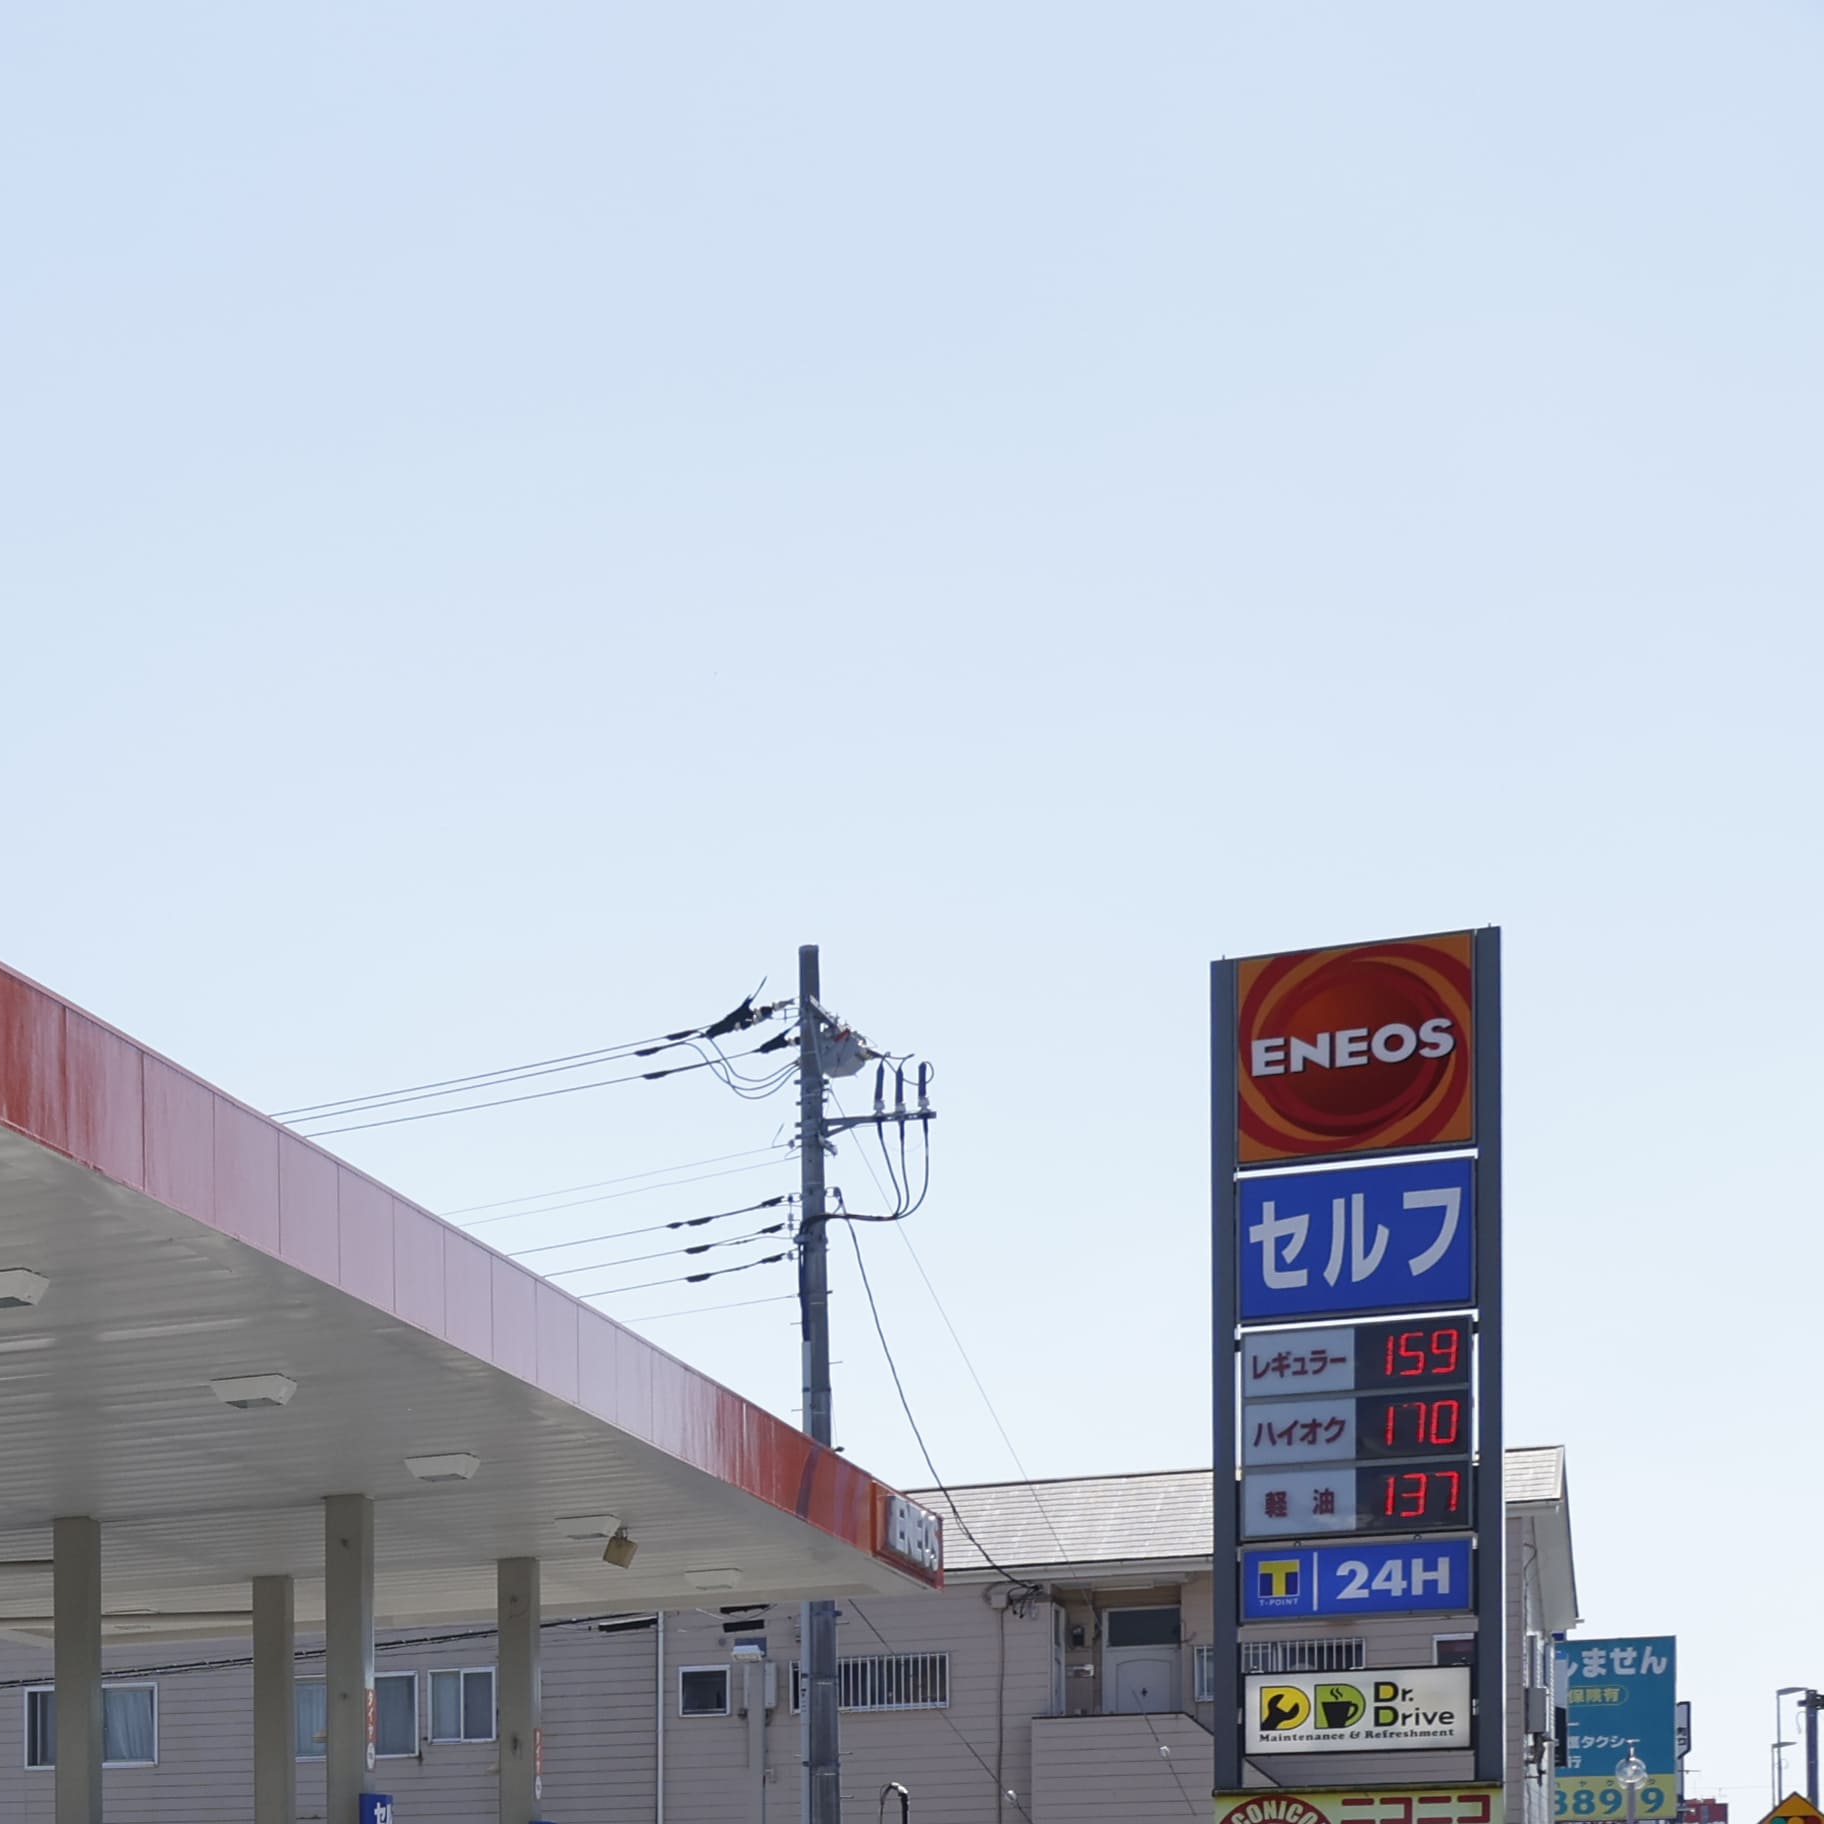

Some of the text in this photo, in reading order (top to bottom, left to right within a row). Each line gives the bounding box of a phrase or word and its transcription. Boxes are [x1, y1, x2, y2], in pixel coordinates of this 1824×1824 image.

[1251, 1018, 1455, 1077] ENEOS
[1249, 1187, 1462, 1290] セルフ
[1252, 1329, 1459, 1379] レギュラー 159
[1253, 1399, 1459, 1447] ハイオク 170
[1384, 1470, 1459, 1518] 137
[1336, 1556, 1450, 1601] 24H
[1374, 1681, 1414, 1703] Dr.
[1259, 1732, 1345, 1743] Maintenance
[1365, 1729, 1455, 1740] Refreshment
[1374, 1706, 1455, 1727] Drive
